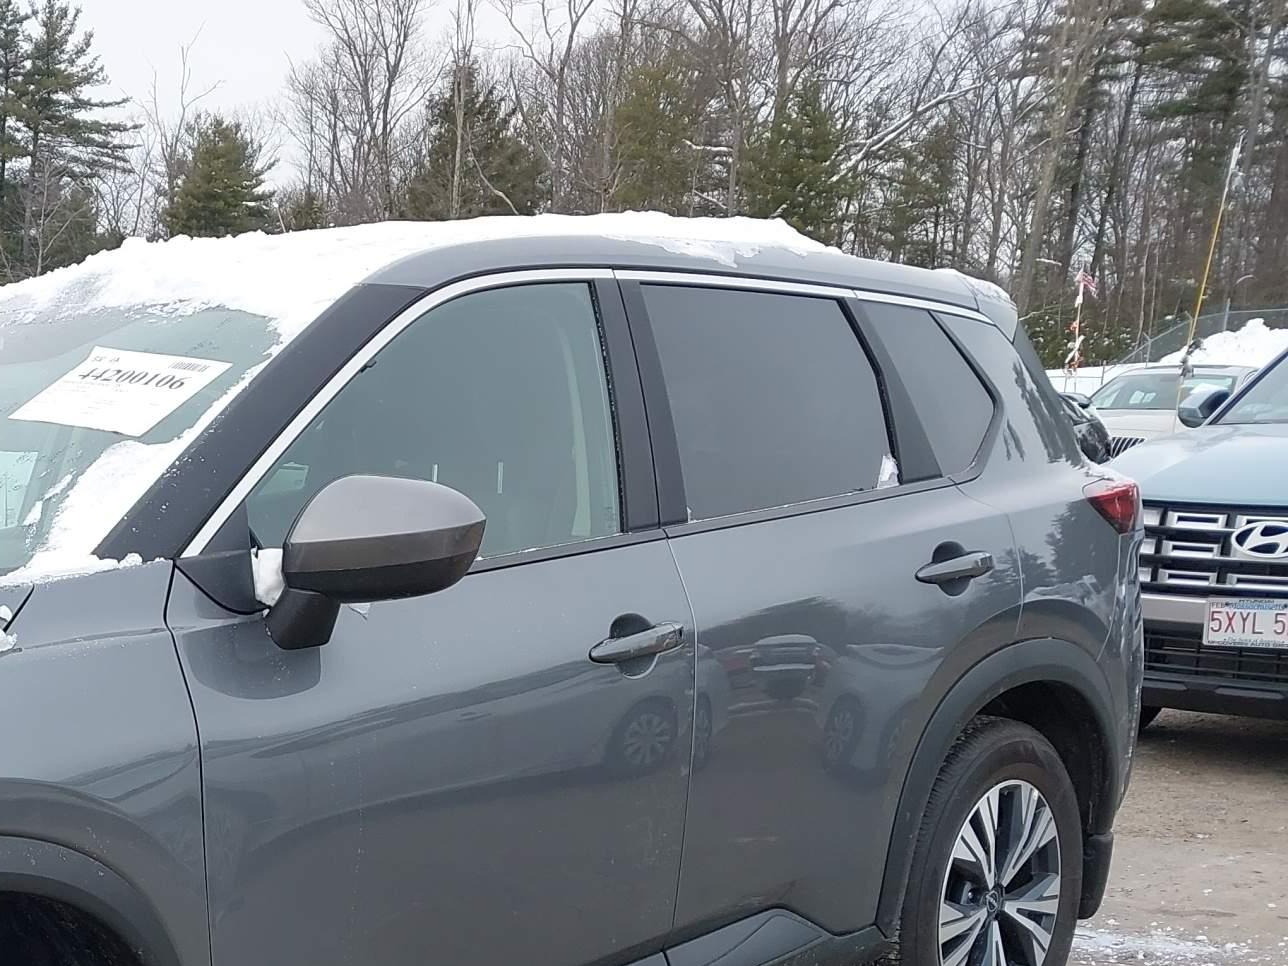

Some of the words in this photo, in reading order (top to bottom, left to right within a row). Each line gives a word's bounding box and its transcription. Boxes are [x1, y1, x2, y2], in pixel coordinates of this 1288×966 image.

[79, 367, 192, 390] 44200106
[1210, 611, 1264, 635] 5XYL
[1273, 613, 1288, 636] 5
